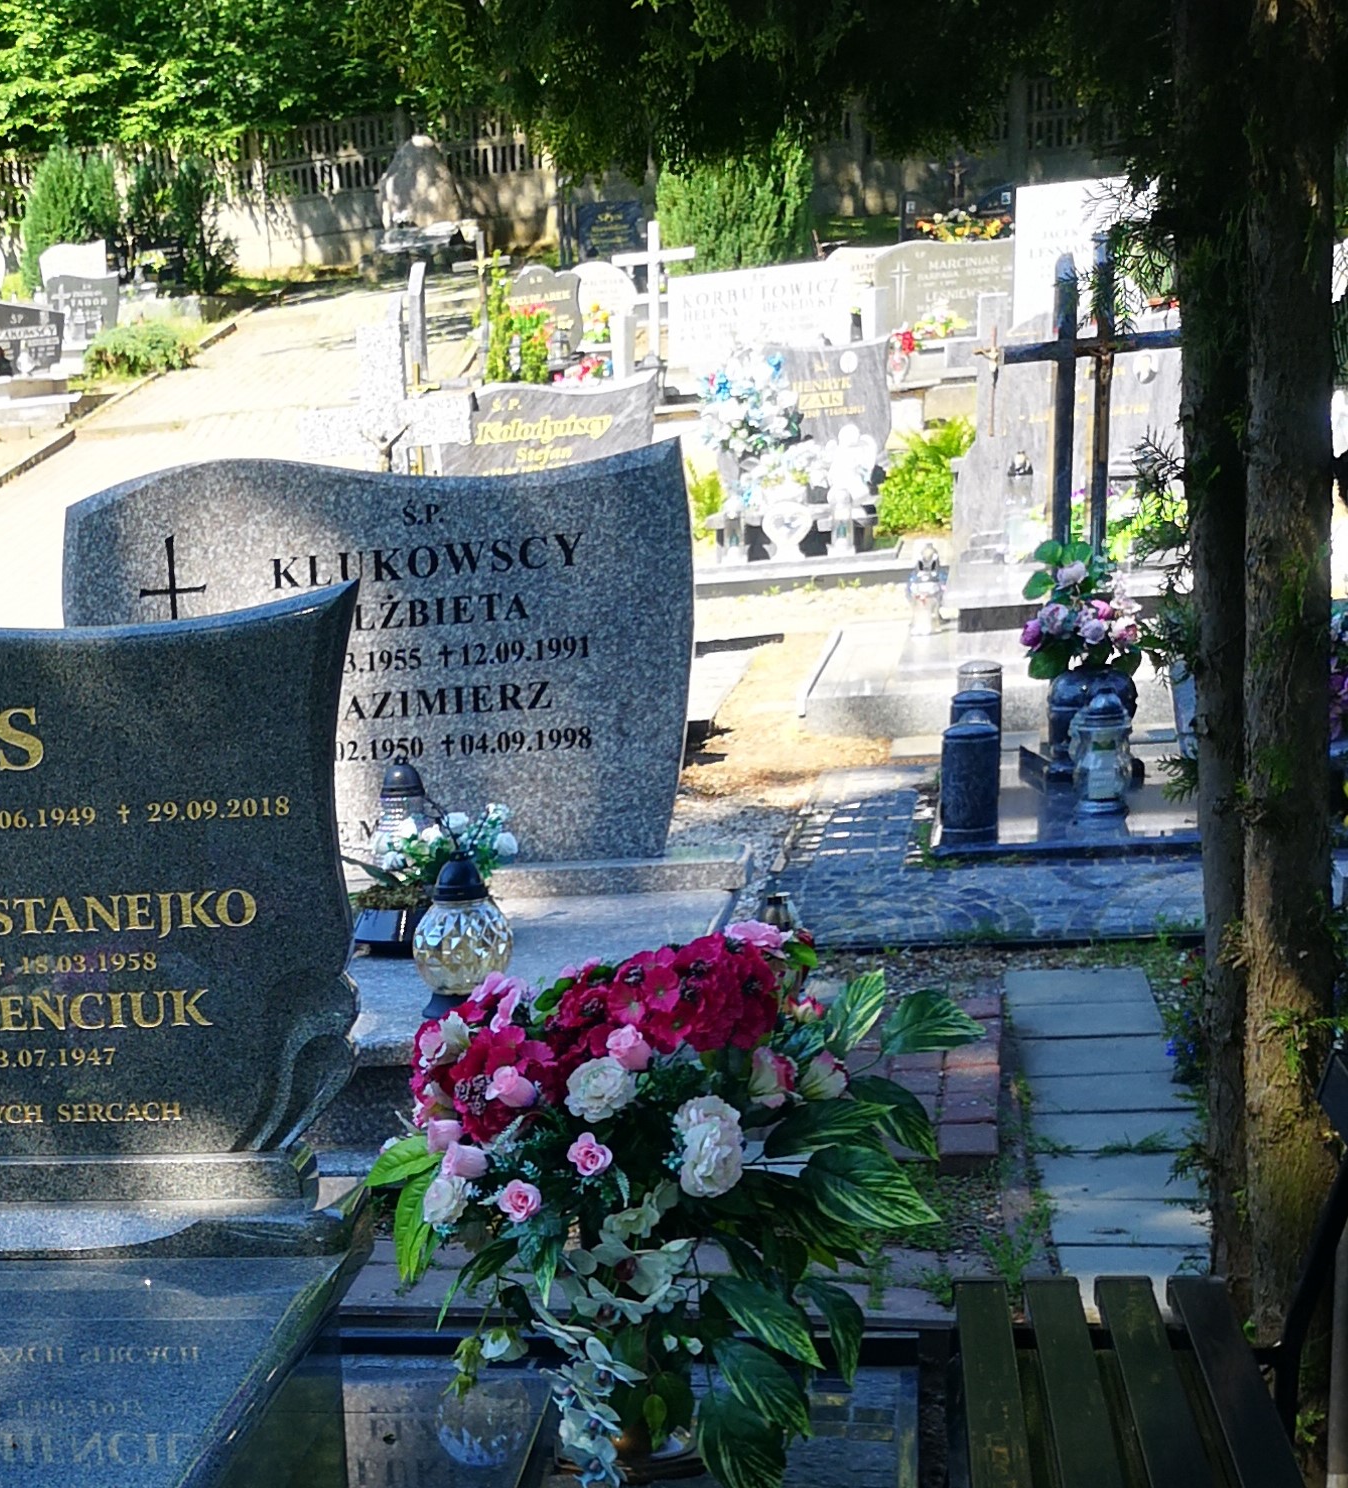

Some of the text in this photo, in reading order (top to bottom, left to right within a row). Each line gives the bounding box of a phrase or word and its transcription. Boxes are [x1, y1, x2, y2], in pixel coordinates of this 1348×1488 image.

[928, 255, 1000, 270] MARCINIAK
[516, 447, 573, 465] Stefan
[269, 532, 584, 589] KLUKOWSCY
[460, 635, 591, 667] 12.09.1991
[460, 727, 593, 757] 04.09.1998
[147, 796, 290, 823] 29.09.2018
[22, 953, 157, 975] 18.03.1958
[57, 1102, 182, 1123] SERCACH
